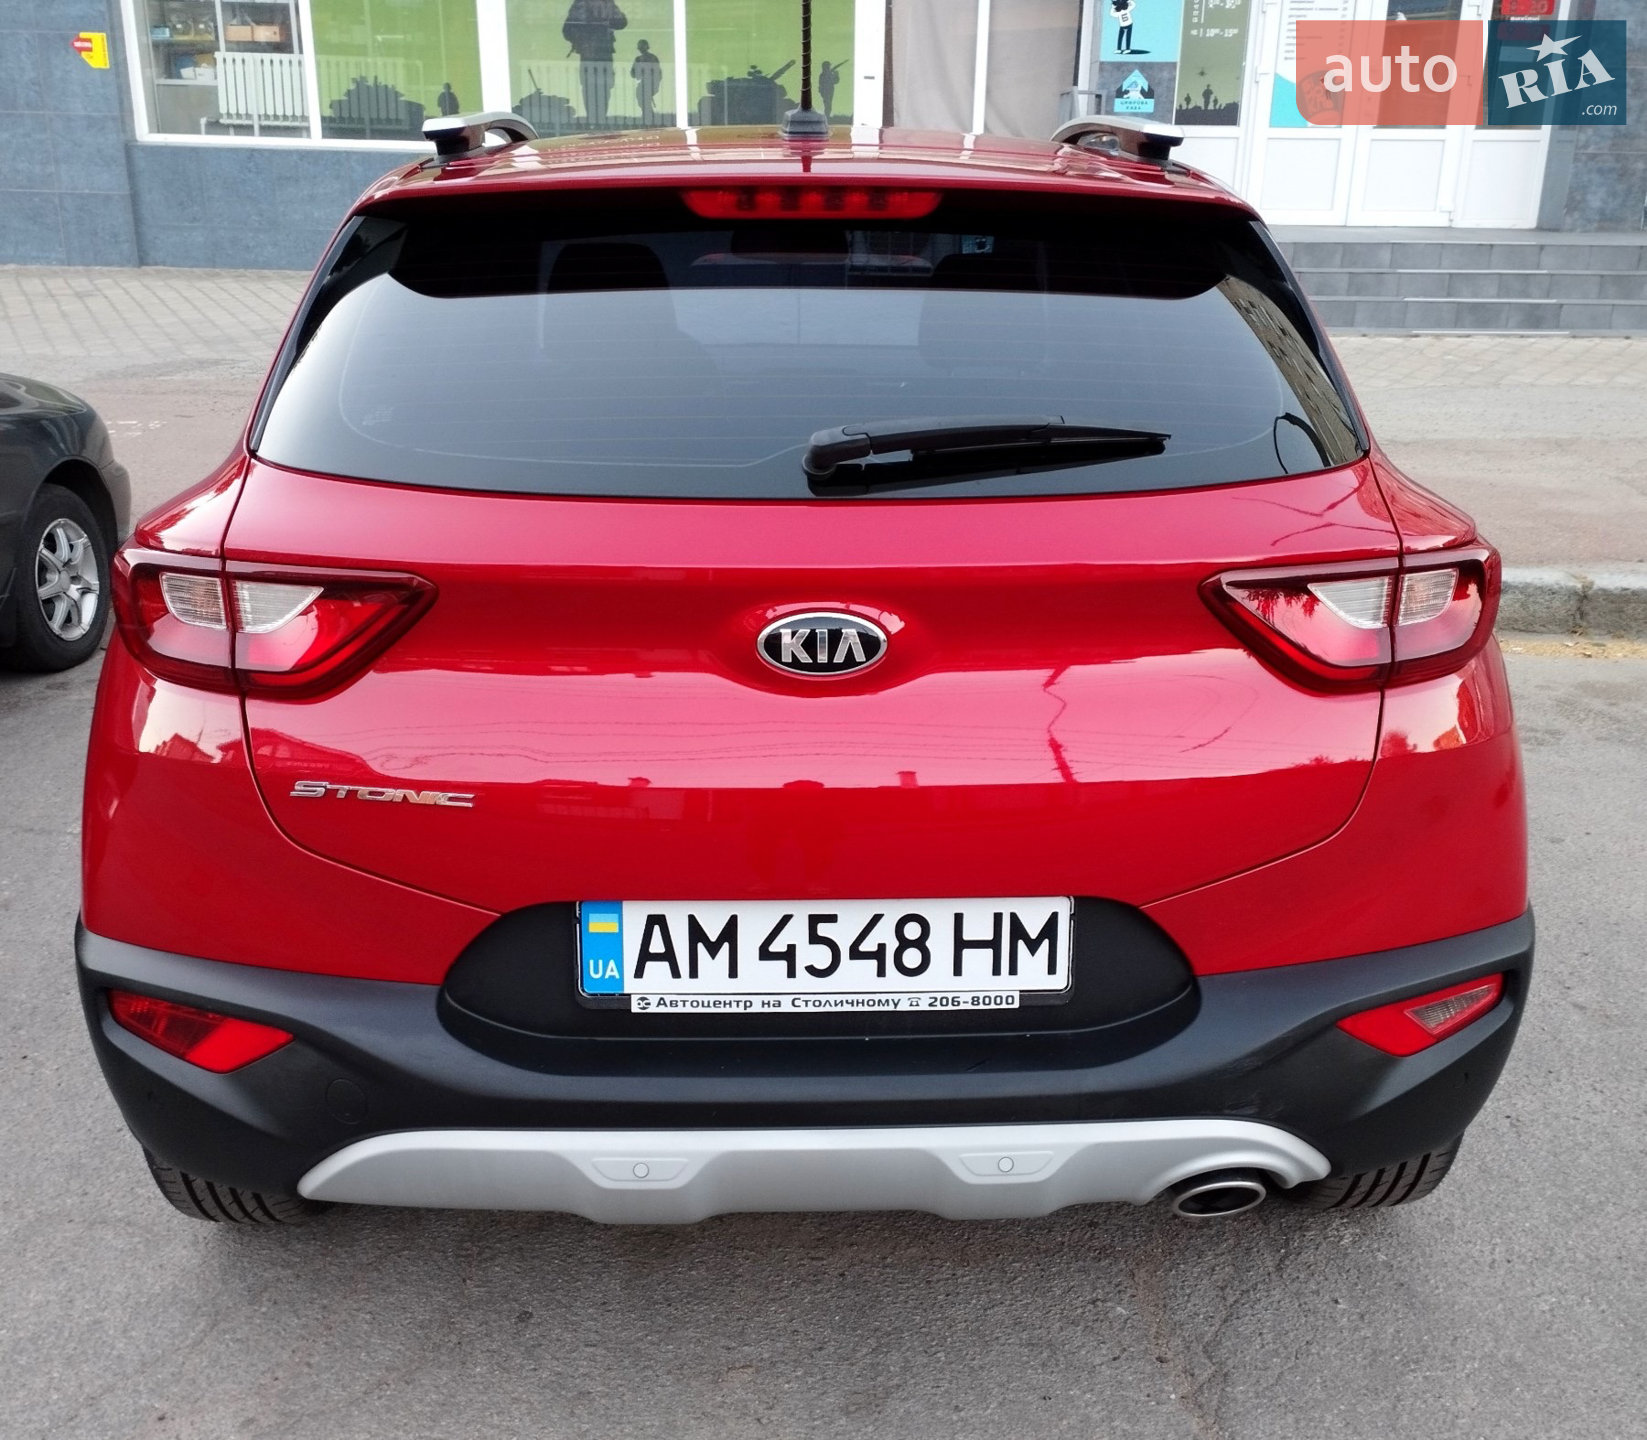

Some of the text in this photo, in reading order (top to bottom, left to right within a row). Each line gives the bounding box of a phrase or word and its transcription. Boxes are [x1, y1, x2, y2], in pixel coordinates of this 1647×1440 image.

[780, 628, 867, 663] KIA
[290, 780, 475, 808] STONIC
[633, 911, 1059, 980] AM 4548 HM
[588, 959, 620, 980] UA
[655, 994, 1015, 1011] Автоцентр на Столичному 206-8000
